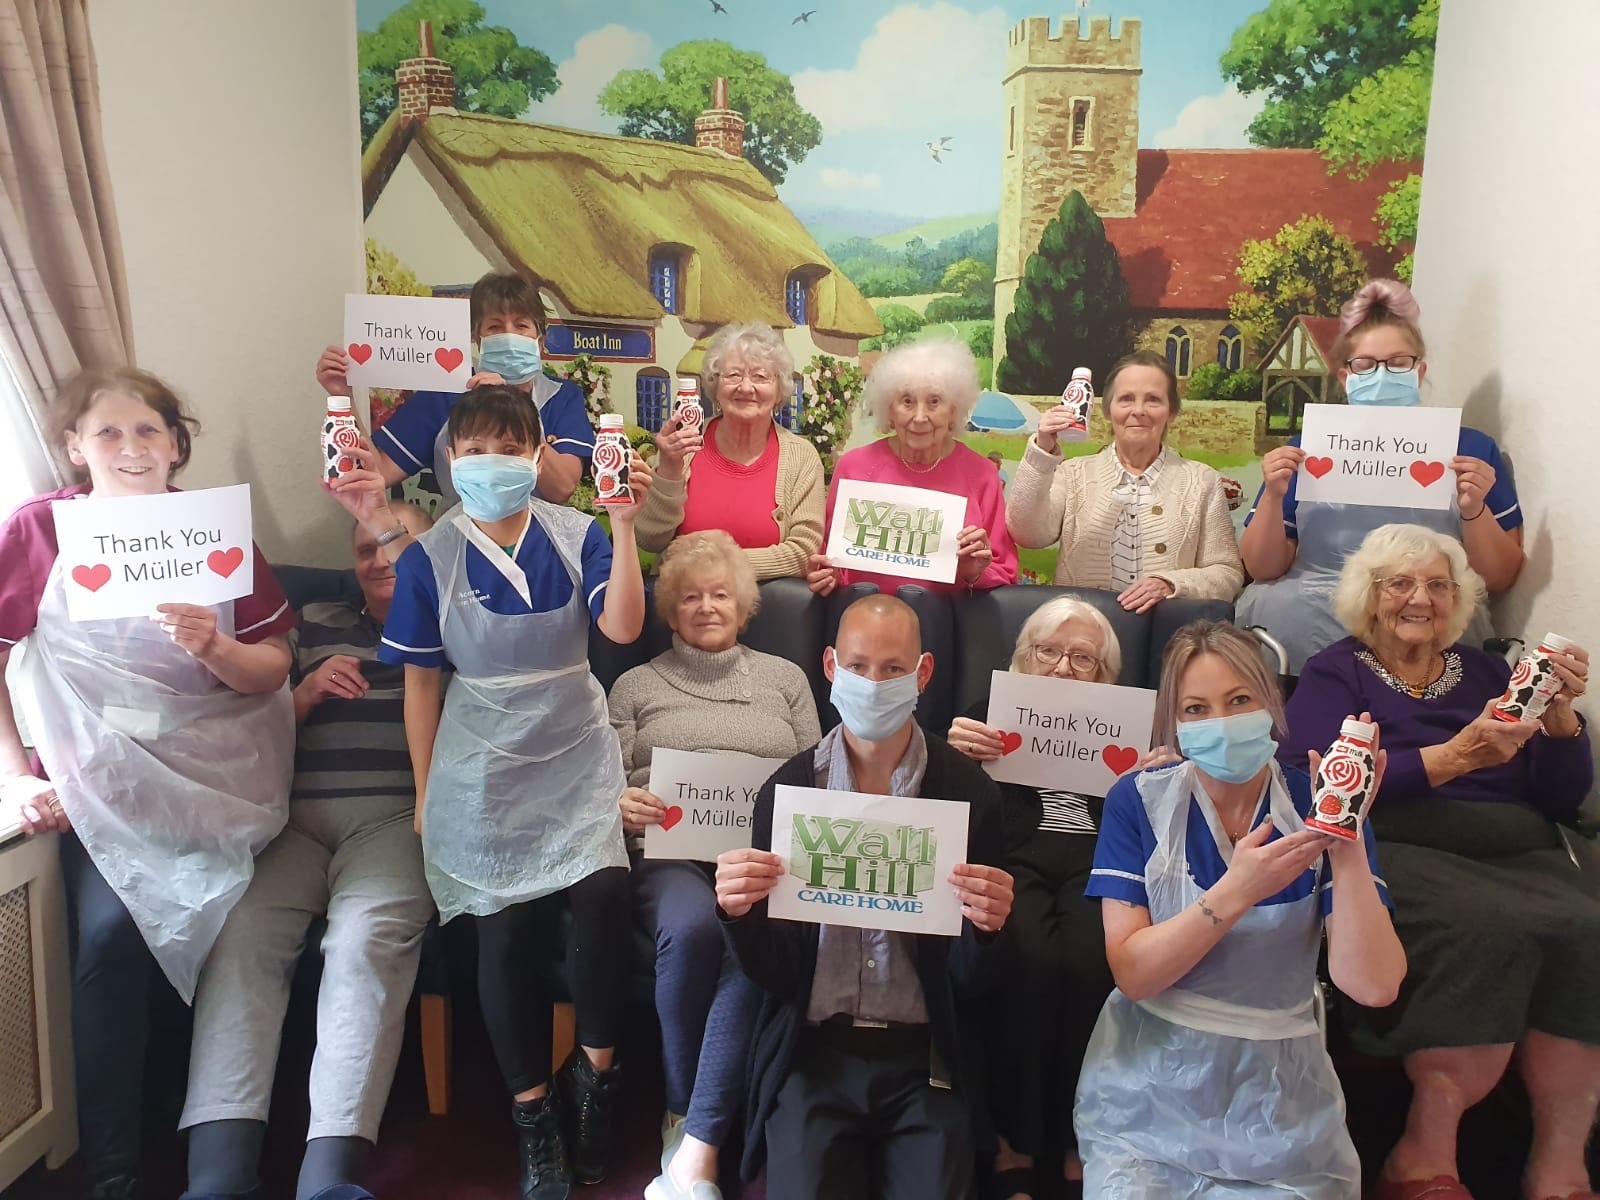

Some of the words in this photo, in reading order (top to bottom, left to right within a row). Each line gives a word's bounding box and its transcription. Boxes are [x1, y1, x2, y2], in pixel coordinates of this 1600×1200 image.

[364, 322, 413, 340] Thank
[418, 326, 446, 341] You
[573, 331, 600, 349] Boat
[603, 333, 622, 350] Inn
[379, 346, 433, 363] Müller
[1327, 434, 1386, 452] Thank
[1393, 437, 1427, 454] You
[1342, 459, 1407, 477] Müller
[848, 498, 944, 534] Wall
[93, 529, 174, 554] Thank
[180, 528, 221, 547] You
[852, 523, 928, 557] Hill
[845, 547, 883, 561] CARE
[886, 554, 930, 568] HOME
[124, 559, 204, 582] Müller
[1016, 707, 1078, 732] Thank
[1086, 716, 1121, 738] You
[1031, 736, 1100, 762] Müller
[675, 782, 735, 802] Thank
[792, 813, 935, 865] Wall
[805, 852, 919, 898] Hill
[797, 889, 854, 907] CARE
[857, 898, 924, 914] HOME
